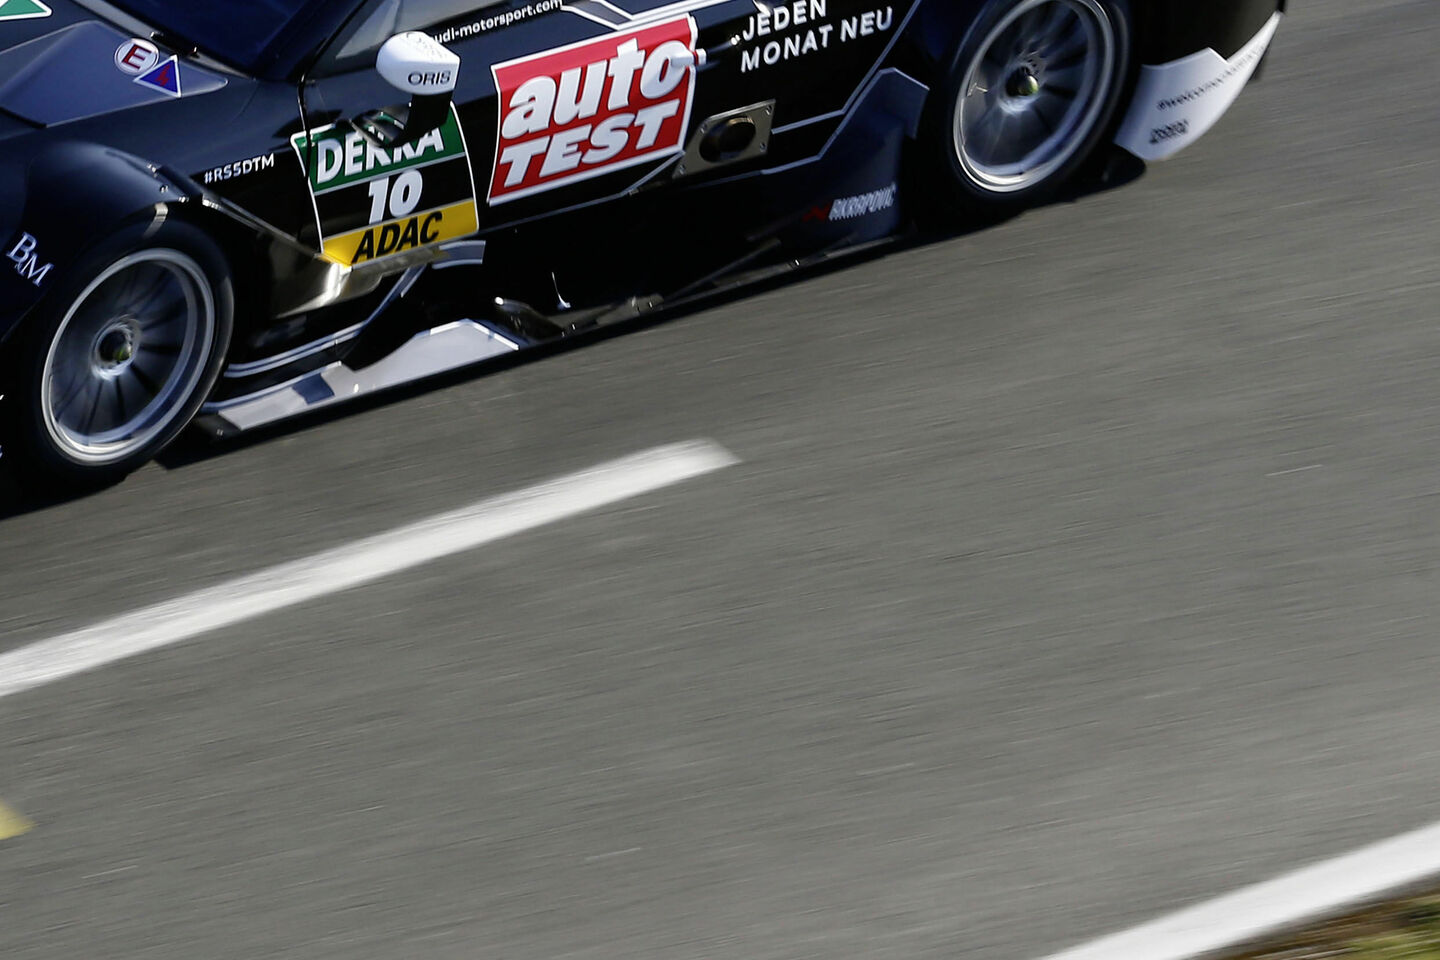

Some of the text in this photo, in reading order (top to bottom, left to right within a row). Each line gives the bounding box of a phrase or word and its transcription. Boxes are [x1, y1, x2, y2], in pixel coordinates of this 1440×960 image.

[121, 43, 153, 70] E
[740, 6, 893, 73] MONAT NEU
[408, 70, 451, 87] ORIS
[501, 37, 694, 140] auto
[499, 98, 681, 188] TEST
[368, 168, 424, 225] 10
[350, 210, 443, 265] ADAC
